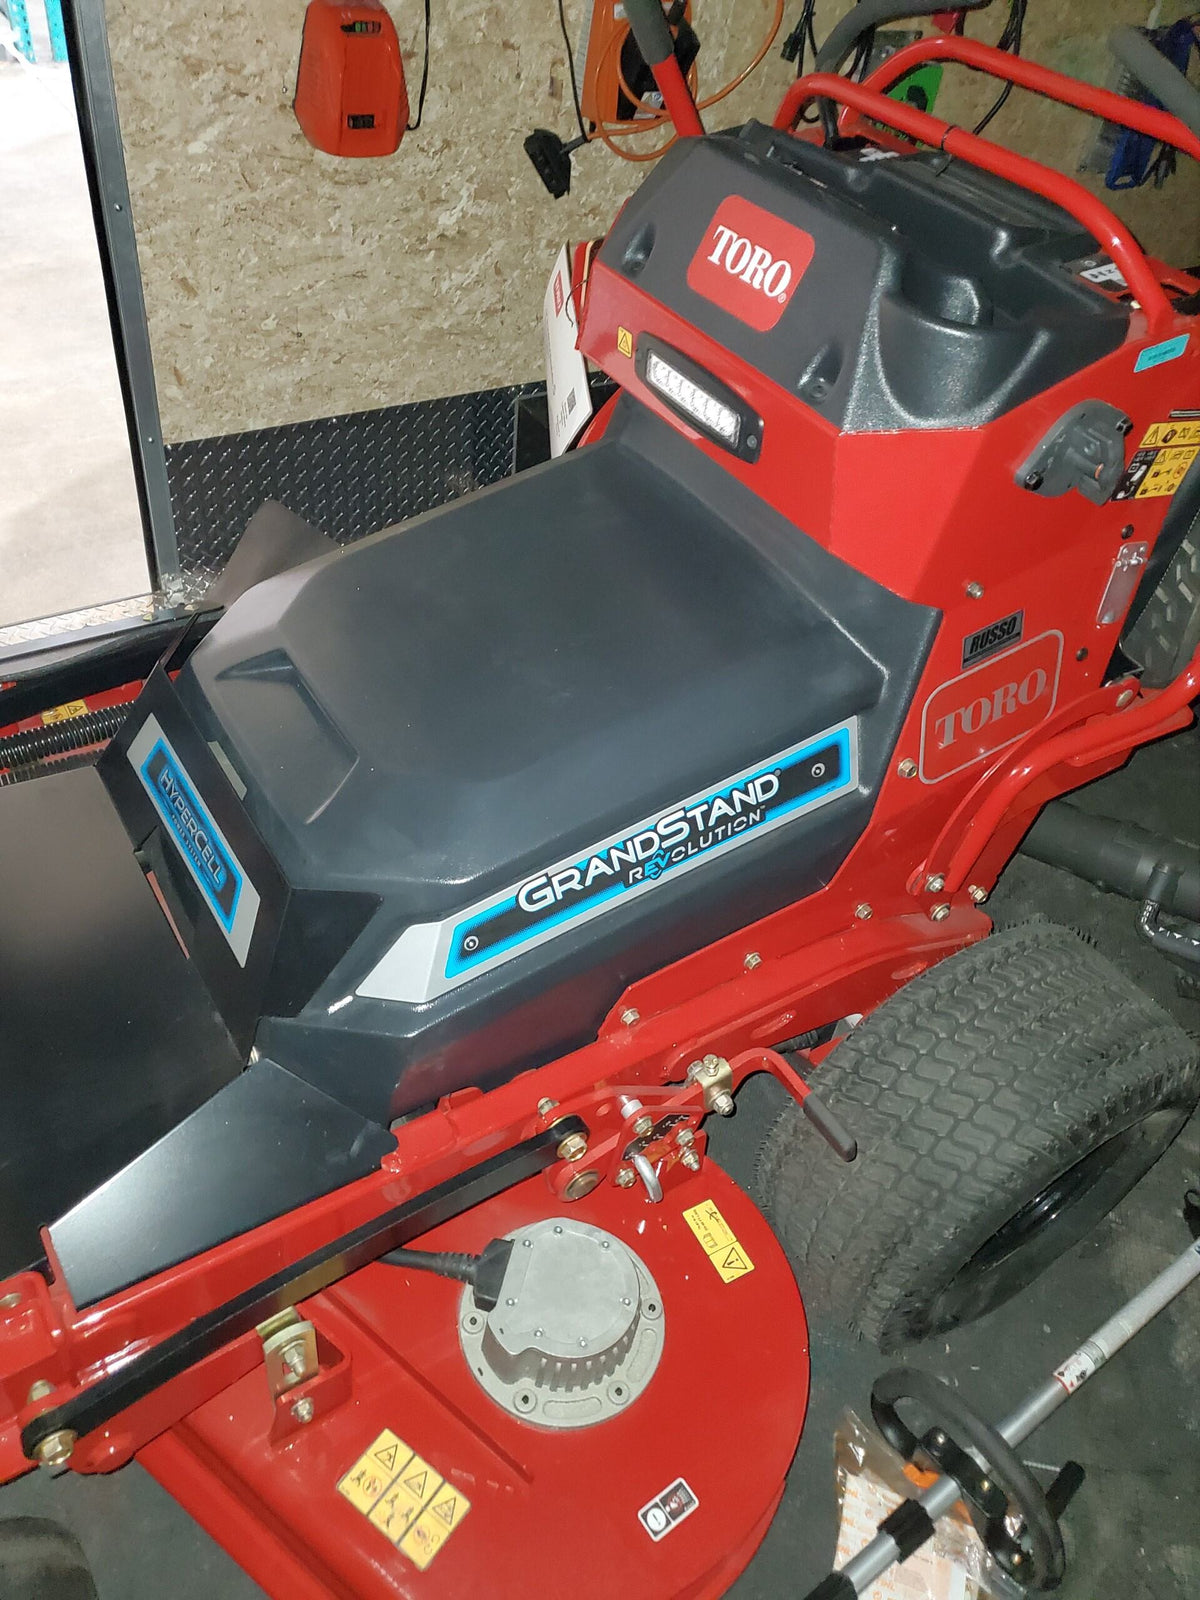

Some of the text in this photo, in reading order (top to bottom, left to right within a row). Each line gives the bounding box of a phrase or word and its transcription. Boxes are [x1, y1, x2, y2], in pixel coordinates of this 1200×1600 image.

[706, 224, 792, 298] TORO
[969, 616, 1018, 655] RUSSO
[934, 667, 1047, 750] TORO
[628, 807, 762, 885] REVOLUTION
